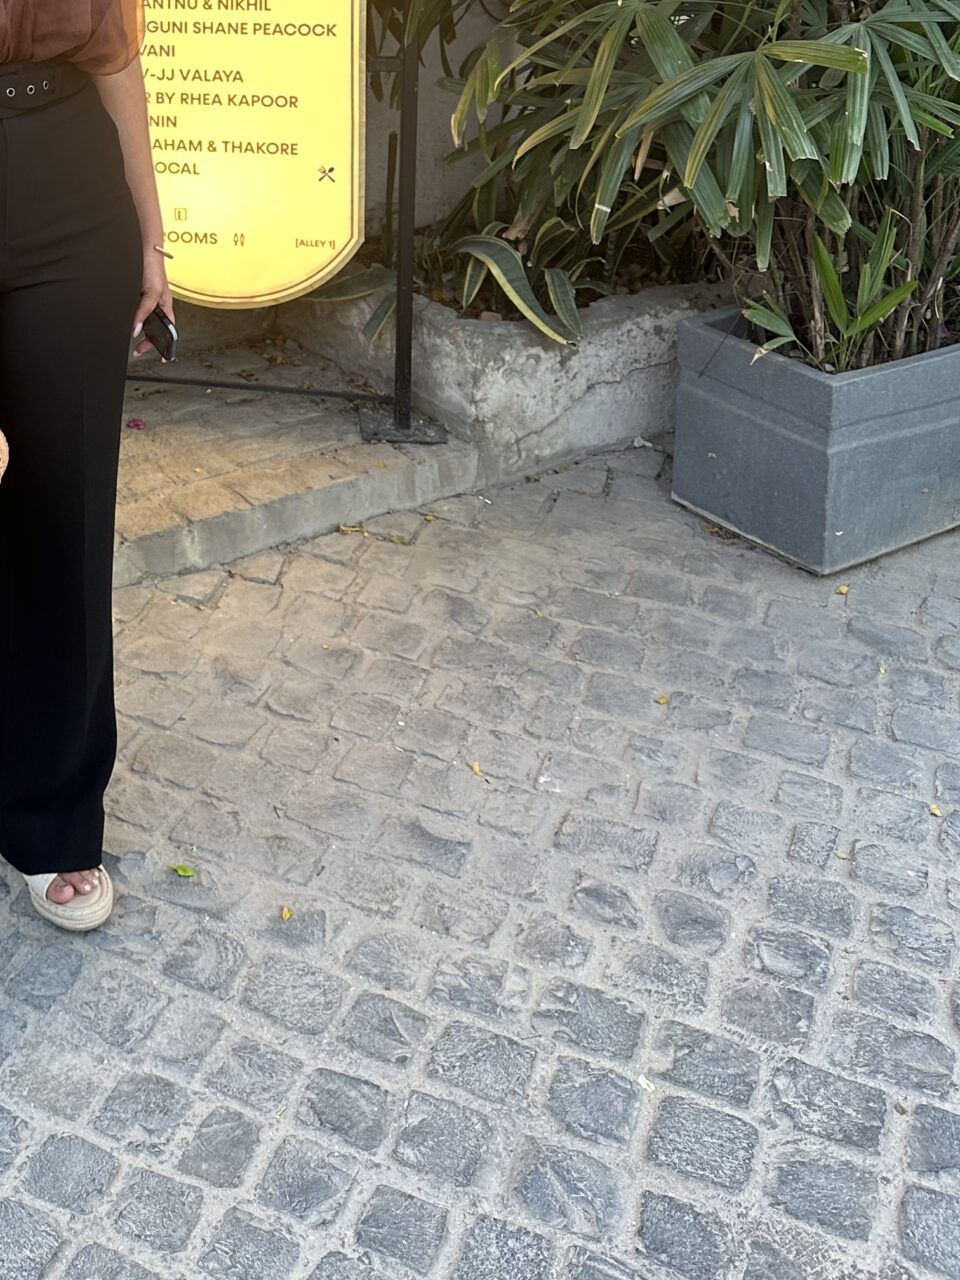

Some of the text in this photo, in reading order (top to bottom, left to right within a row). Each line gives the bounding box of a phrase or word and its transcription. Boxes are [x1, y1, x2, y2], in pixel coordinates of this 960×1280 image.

[146, 20, 337, 37] GUNI SHANE PEACOCK
[179, 68, 244, 83] VALAYA
[156, 91, 176, 105] BY
[180, 92, 223, 106] RHEA
[227, 93, 298, 108] KAPOOR
[149, 115, 177, 128] NIN
[152, 138, 298, 155] AHAM & THAKORE
[155, 161, 200, 175] OCAL
[166, 230, 218, 244] OOMS
